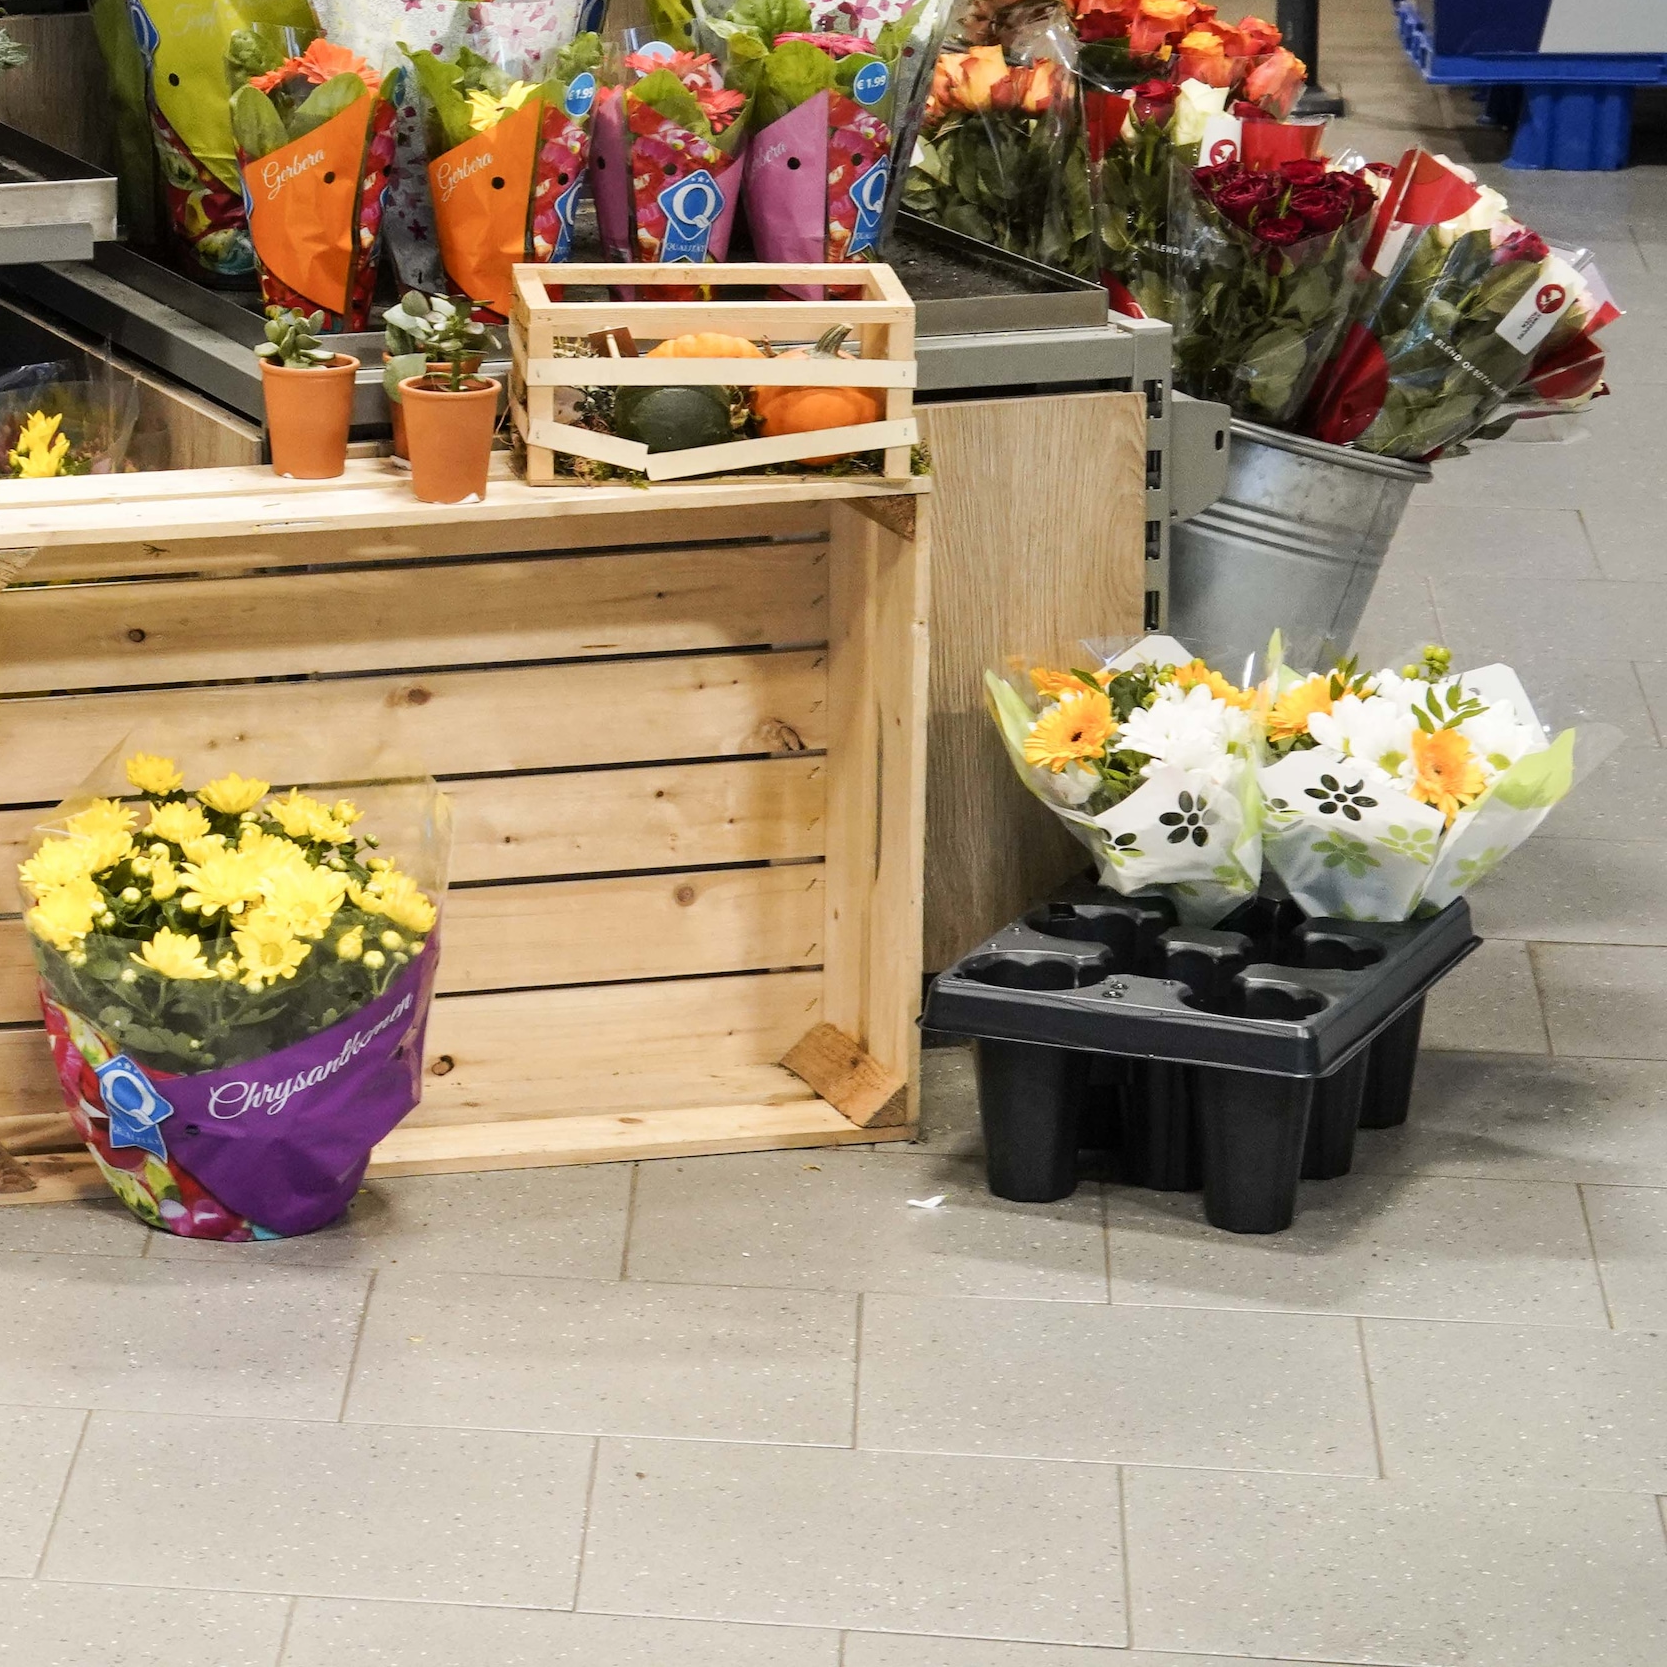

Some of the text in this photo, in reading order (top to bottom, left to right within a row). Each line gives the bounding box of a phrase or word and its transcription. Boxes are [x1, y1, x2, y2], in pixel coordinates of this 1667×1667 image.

[856, 75, 887, 90] €1.99
[260, 147, 327, 200] Gerbera
[436, 151, 494, 203] Gerbera
[860, 168, 890, 215] Q
[672, 183, 716, 229] Q
[1432, 338, 1462, 364] BLEND
[207, 991, 415, 1123] Chrysanthemen
[106, 1067, 160, 1128] Q
